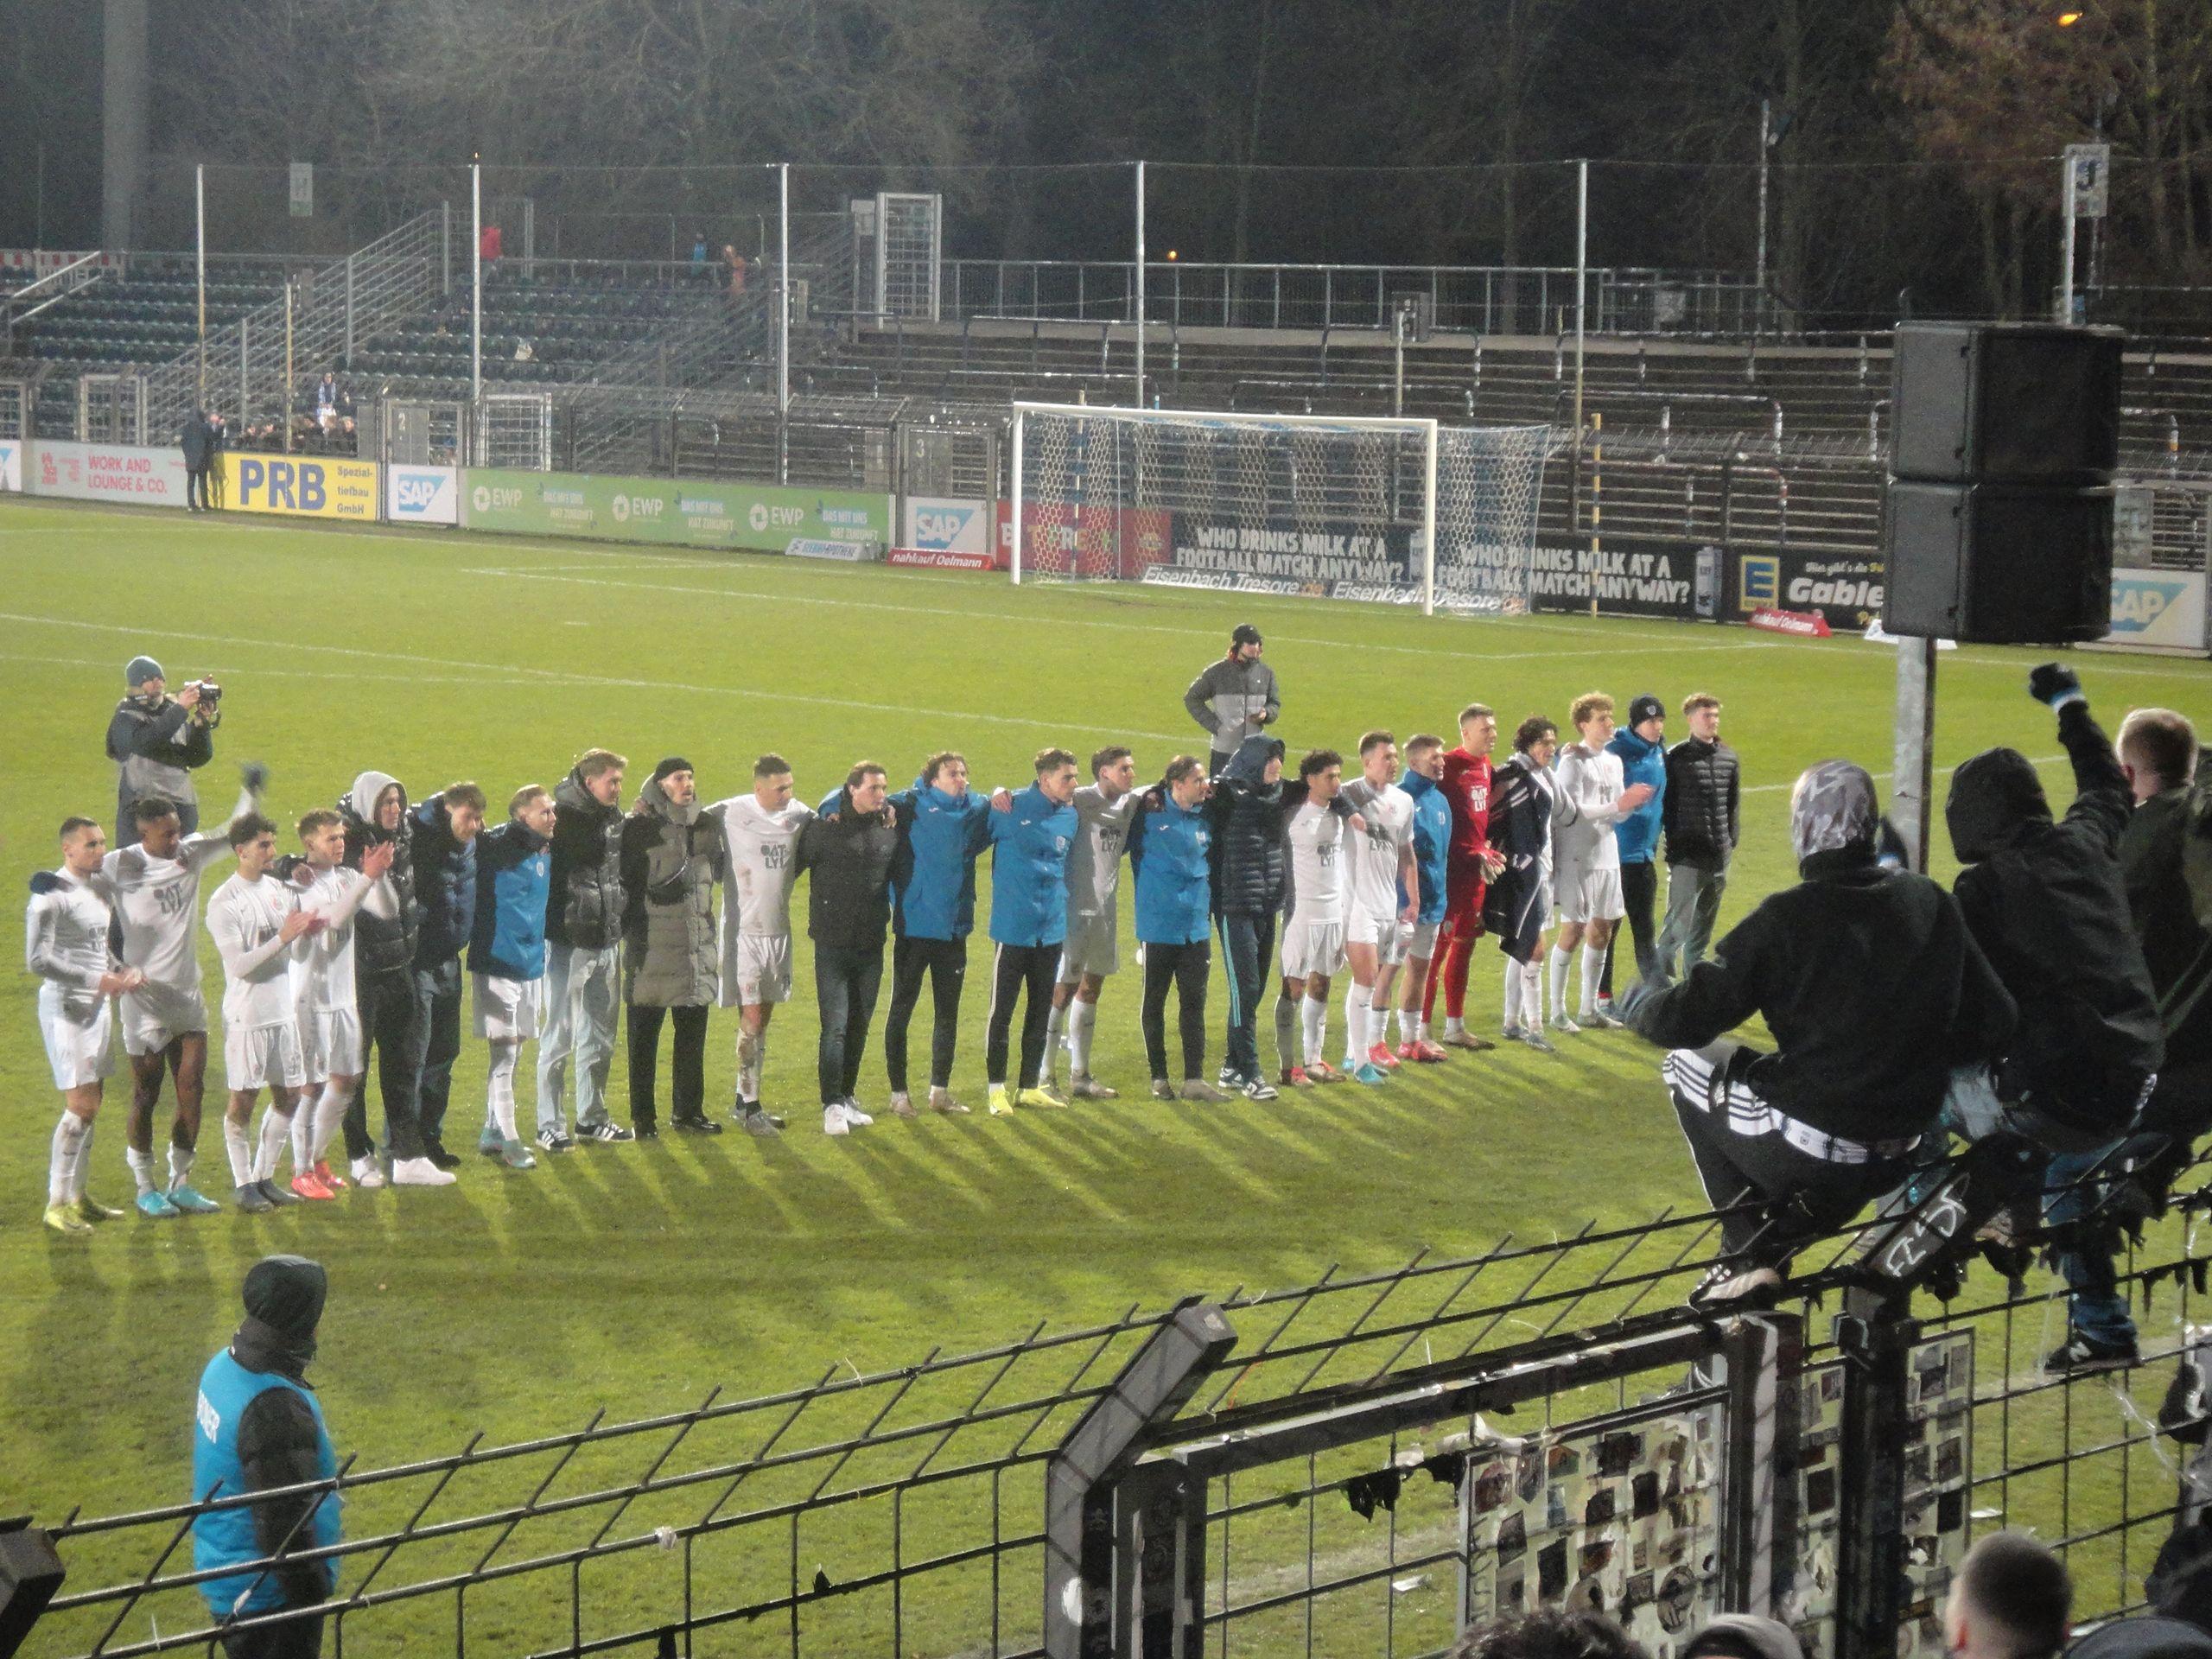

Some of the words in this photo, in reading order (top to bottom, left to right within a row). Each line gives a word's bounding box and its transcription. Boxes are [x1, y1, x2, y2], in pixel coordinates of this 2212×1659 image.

[916, 439, 925, 458] 3
[88, 455, 122, 472] WORK
[126, 458, 151, 474] AND
[337, 465, 373, 479] Spezial-
[87, 474, 132, 491] LOUNGE
[135, 478, 144, 493] &
[148, 478, 168, 493] CO.
[239, 459, 327, 511] PRB
[337, 486, 369, 498] tiefbau
[399, 480, 434, 505] SAP
[493, 488, 522, 507] EWP
[337, 502, 365, 514] GmbH
[632, 498, 664, 517] EWP
[772, 506, 804, 525] EWP
[918, 513, 961, 543] SAP
[1198, 526, 1236, 549] WHO
[1240, 528, 1298, 552] DRINKS
[1303, 532, 1345, 556] MILK
[1348, 536, 1371, 558] AT
[1374, 537, 1387, 560] A
[893, 554, 936, 565] nahkauf
[937, 555, 982, 568] Oelmann
[1176, 547, 1253, 572] FOOTBALL
[1257, 553, 1313, 578] MATCH
[1318, 557, 1403, 583] ANYWAY?
[1460, 543, 1504, 567] WHO
[1578, 550, 1625, 575] MILK
[1629, 553, 1655, 577] AT
[1656, 555, 1672, 579] A
[1143, 566, 1231, 589] Eisenbach
[1236, 573, 1299, 594] Tresore
[1528, 570, 1591, 596] MATCH
[1597, 576, 1691, 604] ANYWAY?
